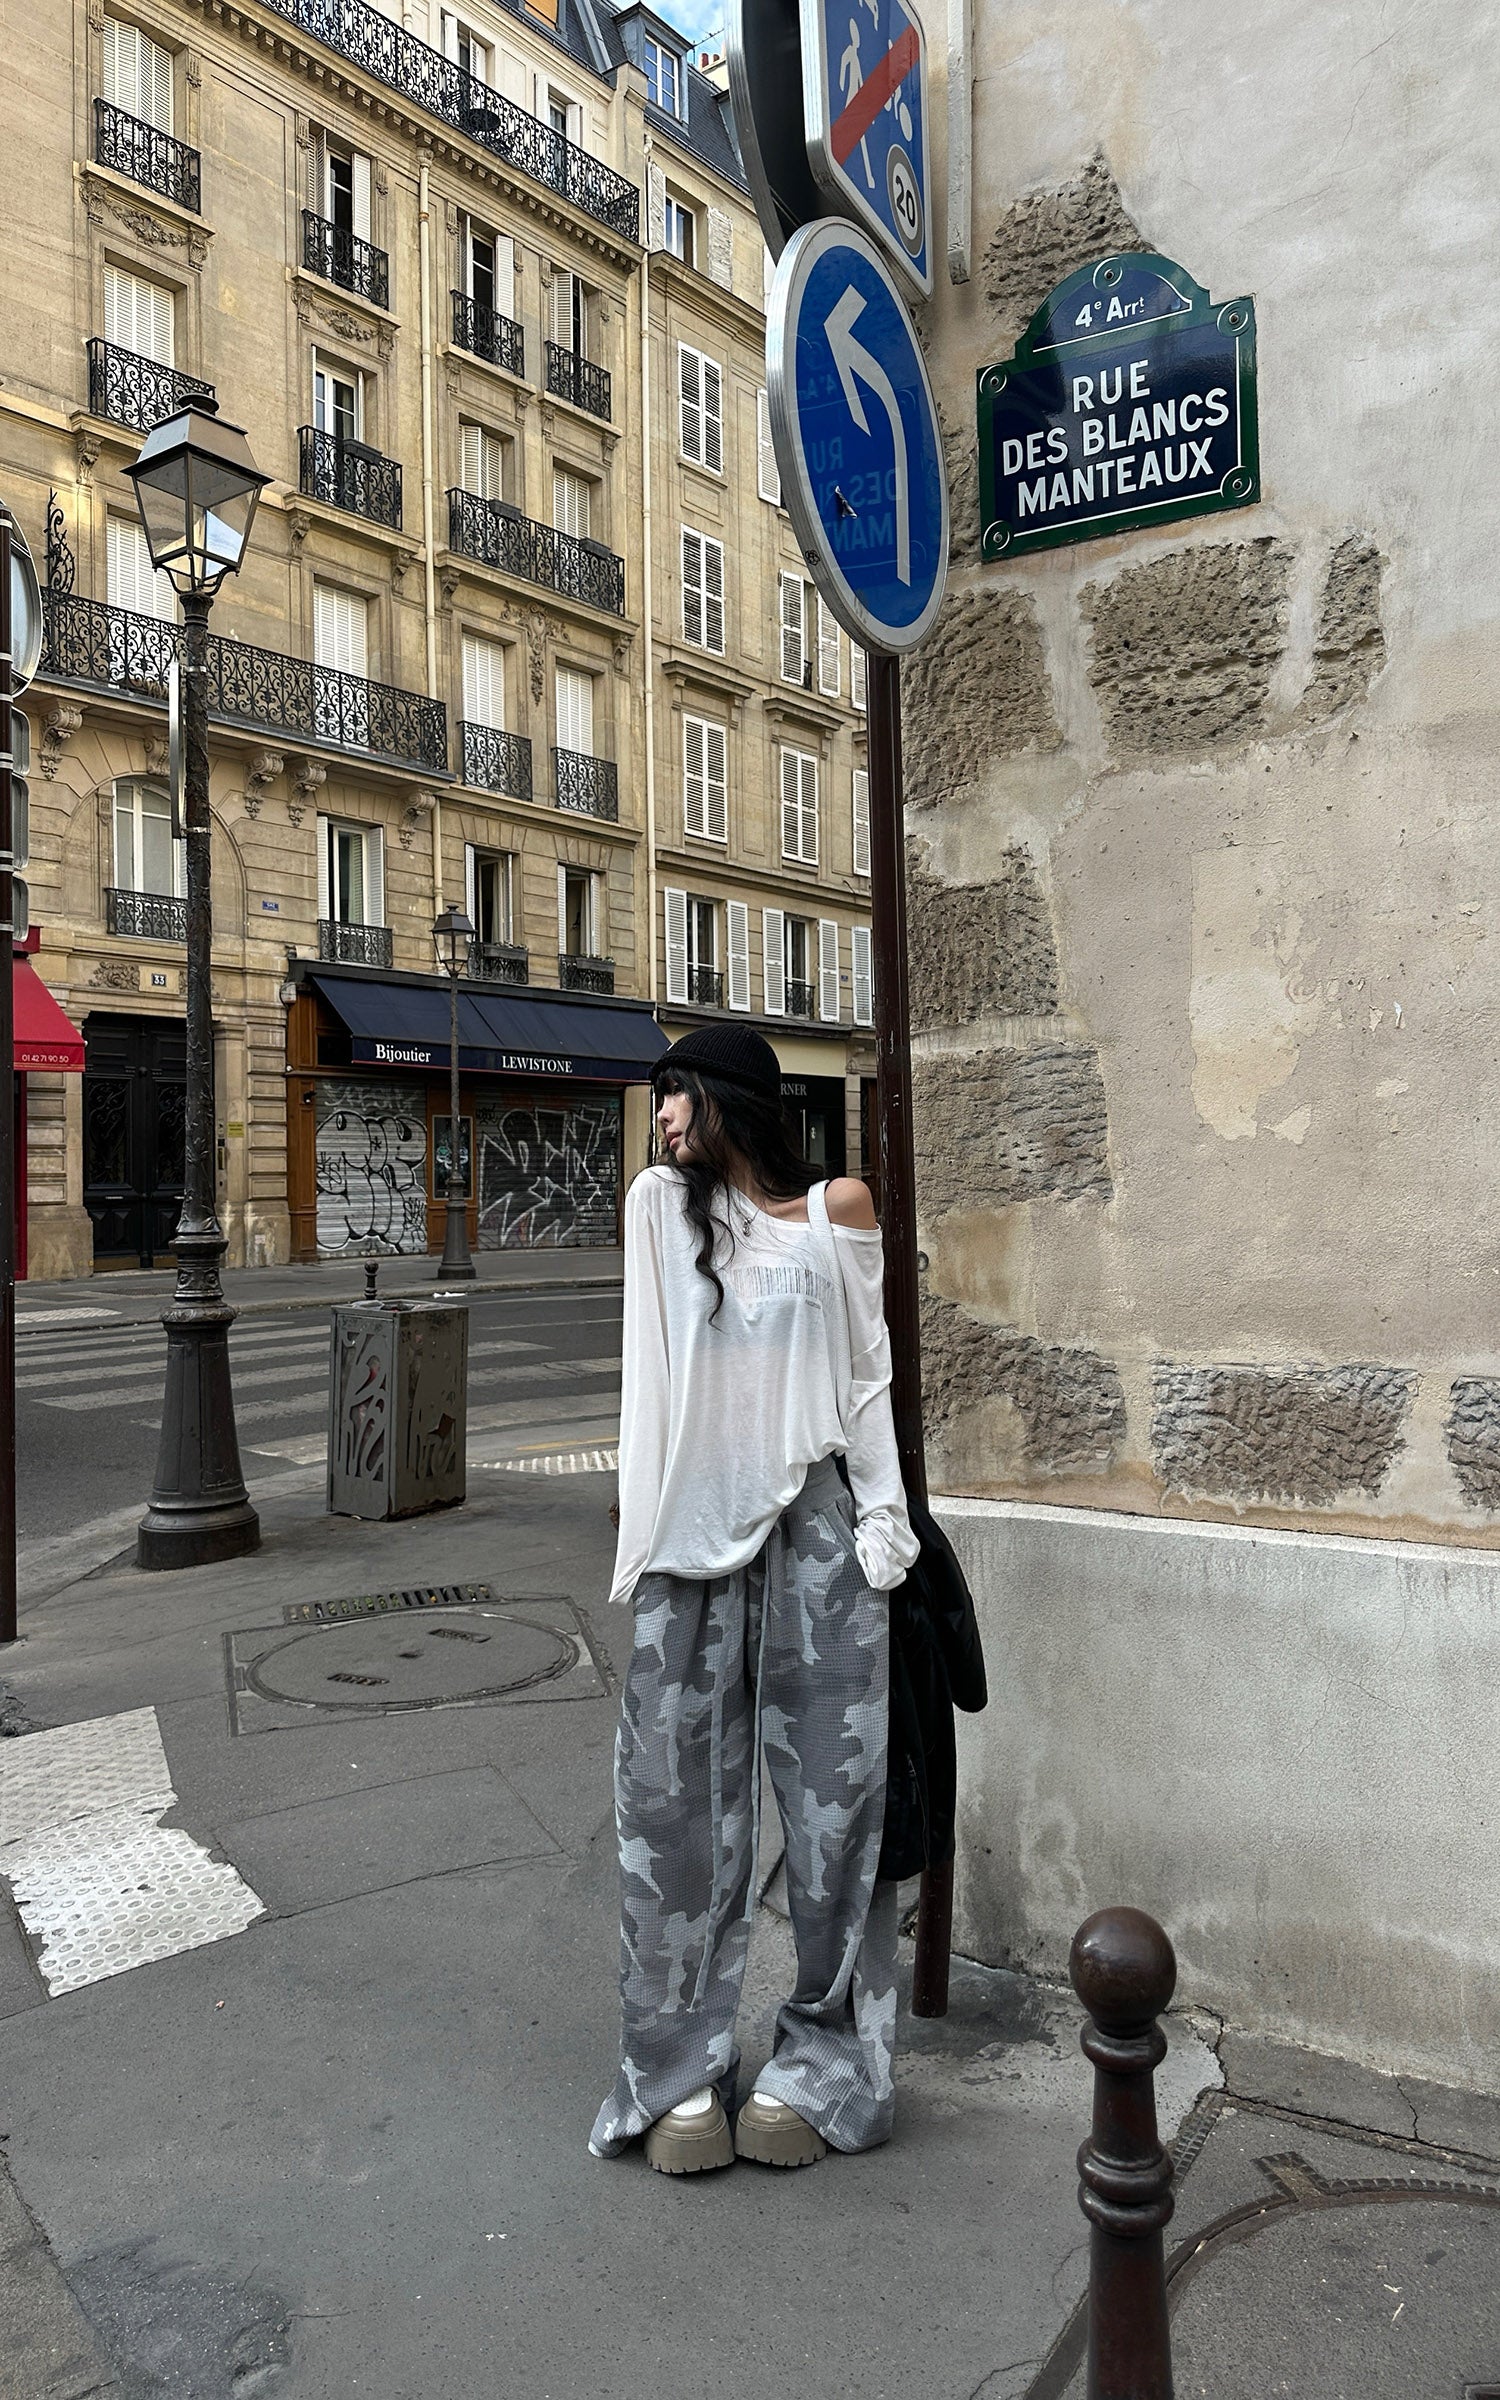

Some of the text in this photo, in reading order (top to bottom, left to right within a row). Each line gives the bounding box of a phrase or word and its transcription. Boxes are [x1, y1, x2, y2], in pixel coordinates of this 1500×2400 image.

[895, 175, 915, 228] 20
[1072, 359, 1150, 413] RUE
[1002, 387, 1230, 476] DES BLANCS
[1018, 436, 1214, 517] MANTEAUX
[154, 974, 165, 985] 33
[21, 1054, 30, 1062] 01
[31, 1054, 39, 1062] 42
[48, 1055, 58, 1063] 90
[58, 1055, 69, 1063] 50
[375, 1043, 574, 1074] Bijoutier LEWISTONE
